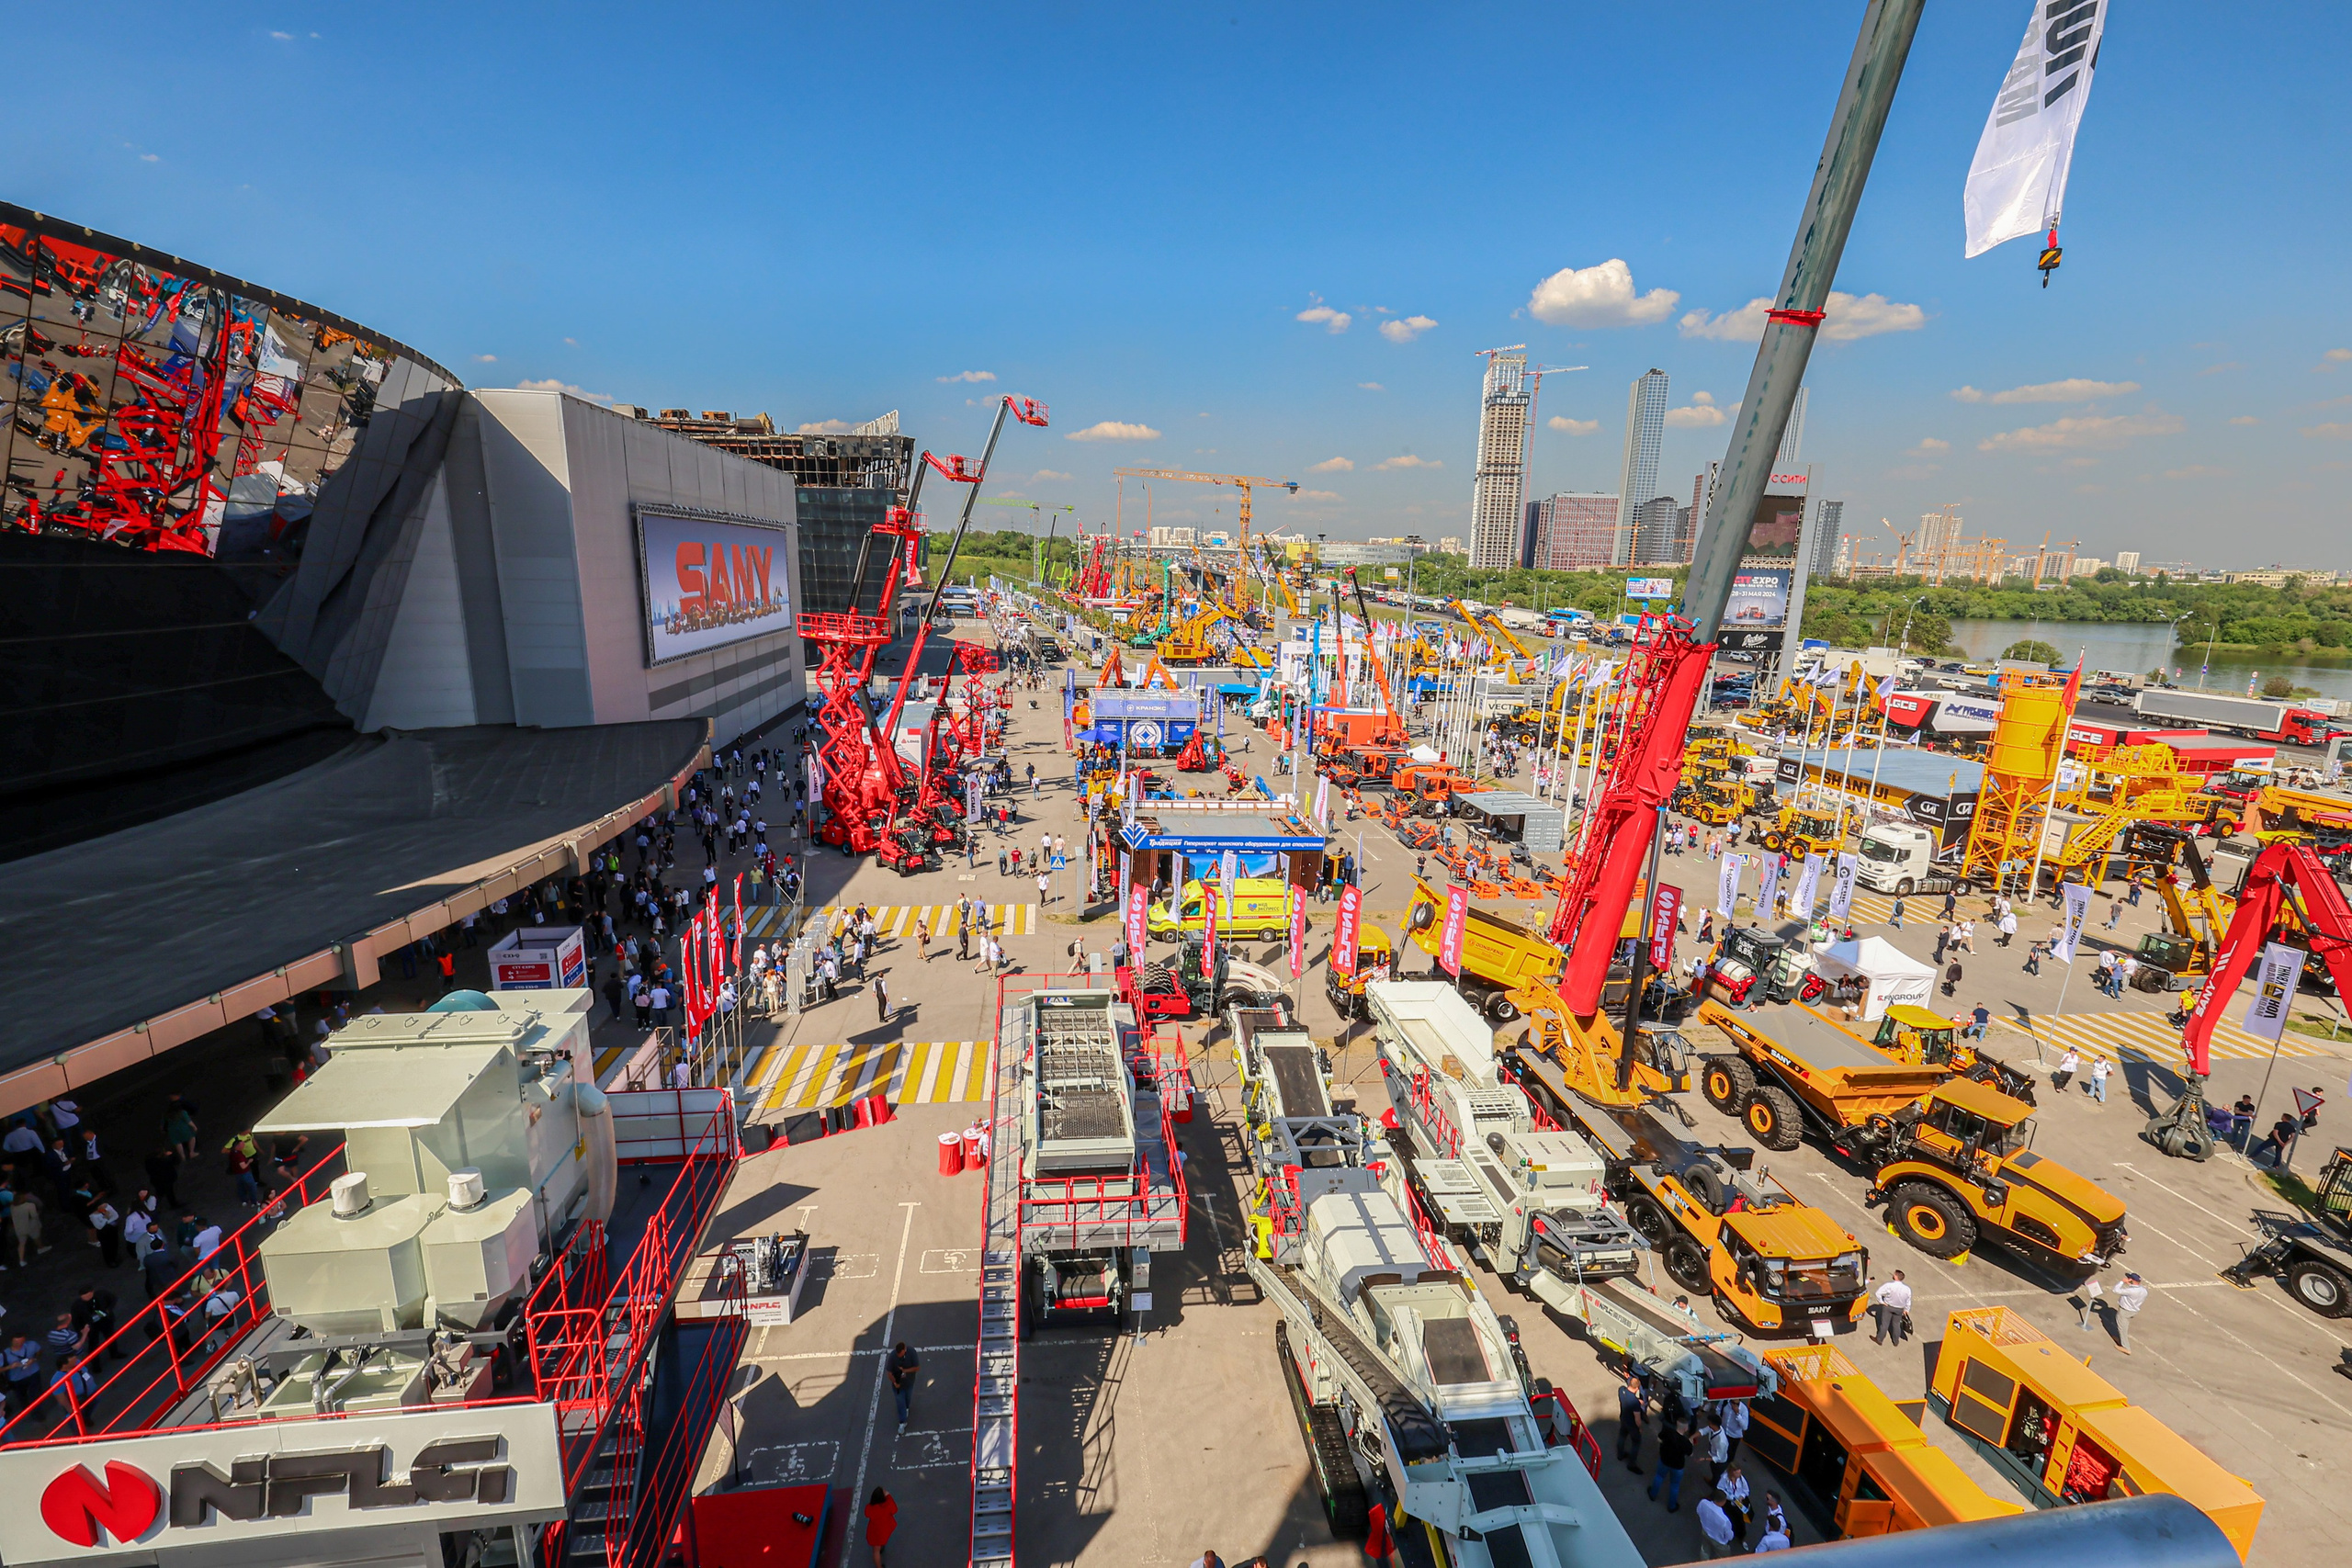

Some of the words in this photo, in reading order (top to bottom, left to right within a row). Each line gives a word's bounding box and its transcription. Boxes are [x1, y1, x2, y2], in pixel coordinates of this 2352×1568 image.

[1781, 474, 1806, 484] СИТИ
[675, 540, 774, 614] SANY
[1885, 698, 1917, 711] LGCE
[2069, 730, 2103, 744] GCE
[1823, 773, 1889, 800] SHANTUI
[1475, 942, 1504, 956] DONGFENG
[2196, 980, 2217, 1018] SANY
[1770, 1049, 1792, 1066] SANY
[1670, 1189, 1690, 1212] SANY
[750, 1302, 781, 1310] NFLG
[1807, 1304, 1831, 1314] SANY
[170, 1433, 511, 1527] NFLG
